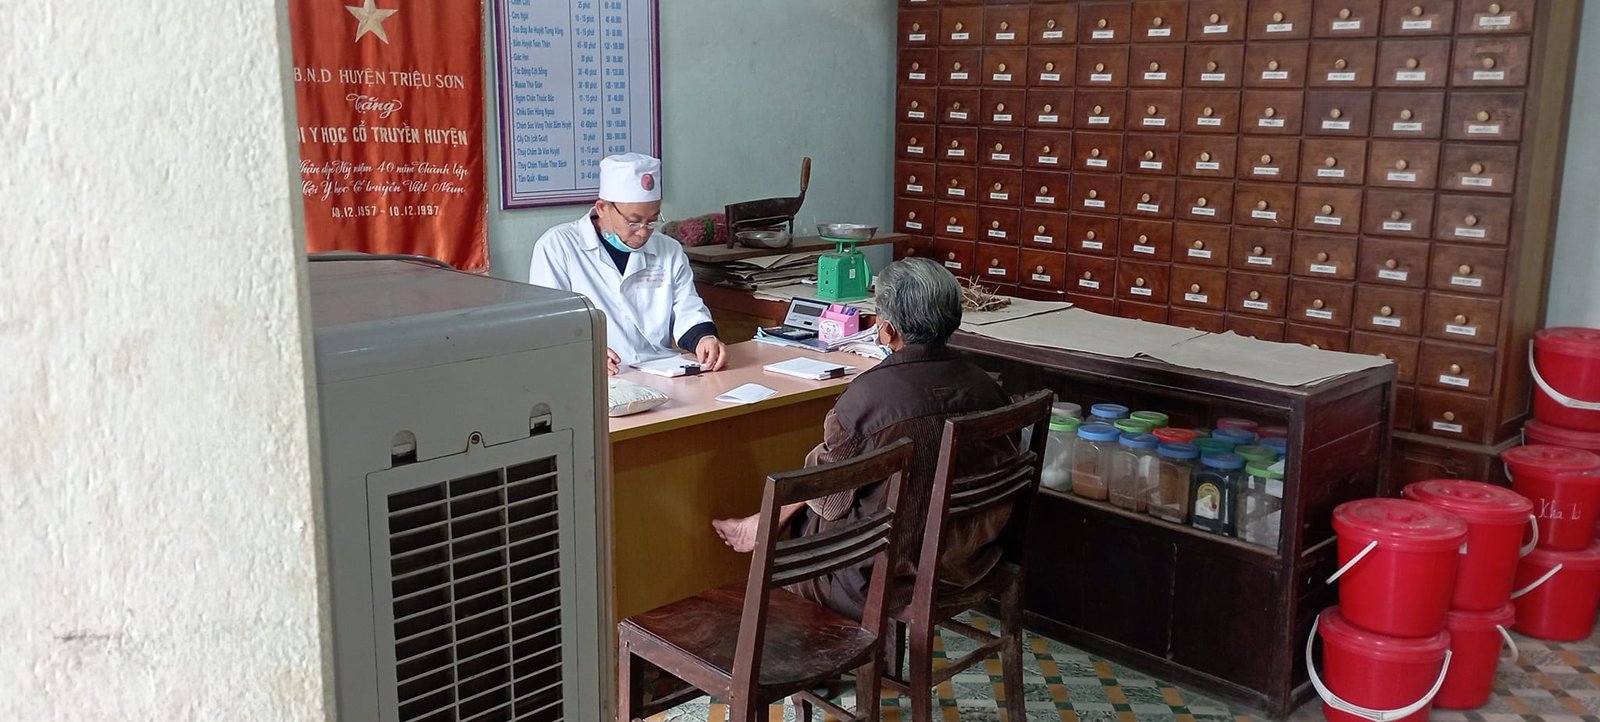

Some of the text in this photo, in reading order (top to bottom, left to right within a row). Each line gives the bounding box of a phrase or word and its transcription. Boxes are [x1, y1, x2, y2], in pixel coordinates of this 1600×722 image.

[339, 68, 386, 88] HUYỆN
[389, 70, 432, 89] TRIỆU
[435, 74, 464, 89] SƠN
[346, 93, 402, 118] Tặng
[308, 127, 318, 143] Y
[321, 127, 348, 146] HỌC
[352, 120, 368, 143] CỔ
[371, 122, 420, 144] TRUYỀN
[424, 127, 468, 148] HUYỆN
[378, 160, 394, 173] 40
[396, 164, 414, 174] năm
[320, 180, 333, 201] Y
[365, 180, 402, 200] truyền
[402, 180, 428, 195] Việt
[432, 182, 466, 194] Nam
[332, 206, 376, 218] 10.12.1957
[390, 205, 440, 217] 10.12.1997
